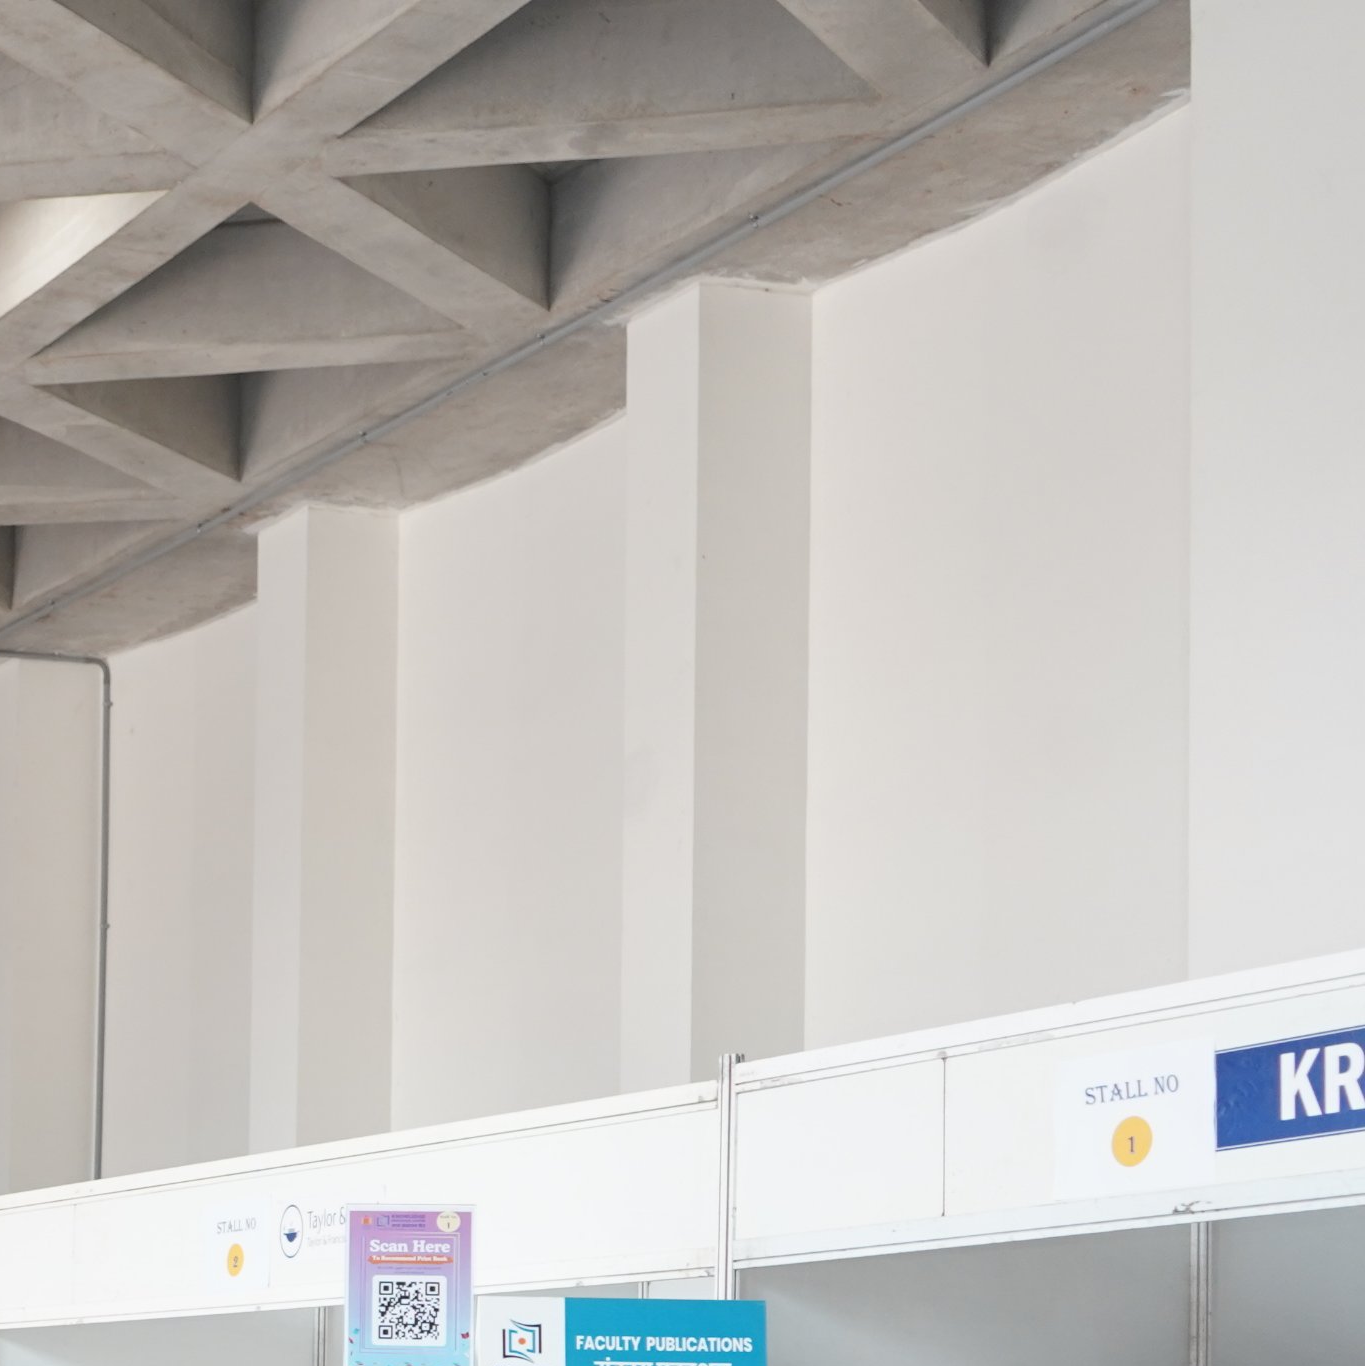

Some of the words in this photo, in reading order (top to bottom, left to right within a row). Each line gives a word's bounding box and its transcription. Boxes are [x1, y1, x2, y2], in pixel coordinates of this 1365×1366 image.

[1085, 1079, 1147, 1104] STALL
[1154, 1074, 1179, 1095] NO
[1127, 1136, 1136, 1154] 1
[217, 1221, 243, 1234] STALL
[246, 1217, 256, 1230] NO
[308, 1208, 336, 1233] Taylor
[369, 1239, 407, 1252] Scan
[412, 1239, 451, 1252] Here
[575, 1335, 641, 1351] FACULTY
[646, 1336, 752, 1353] PUBLICATIONS
